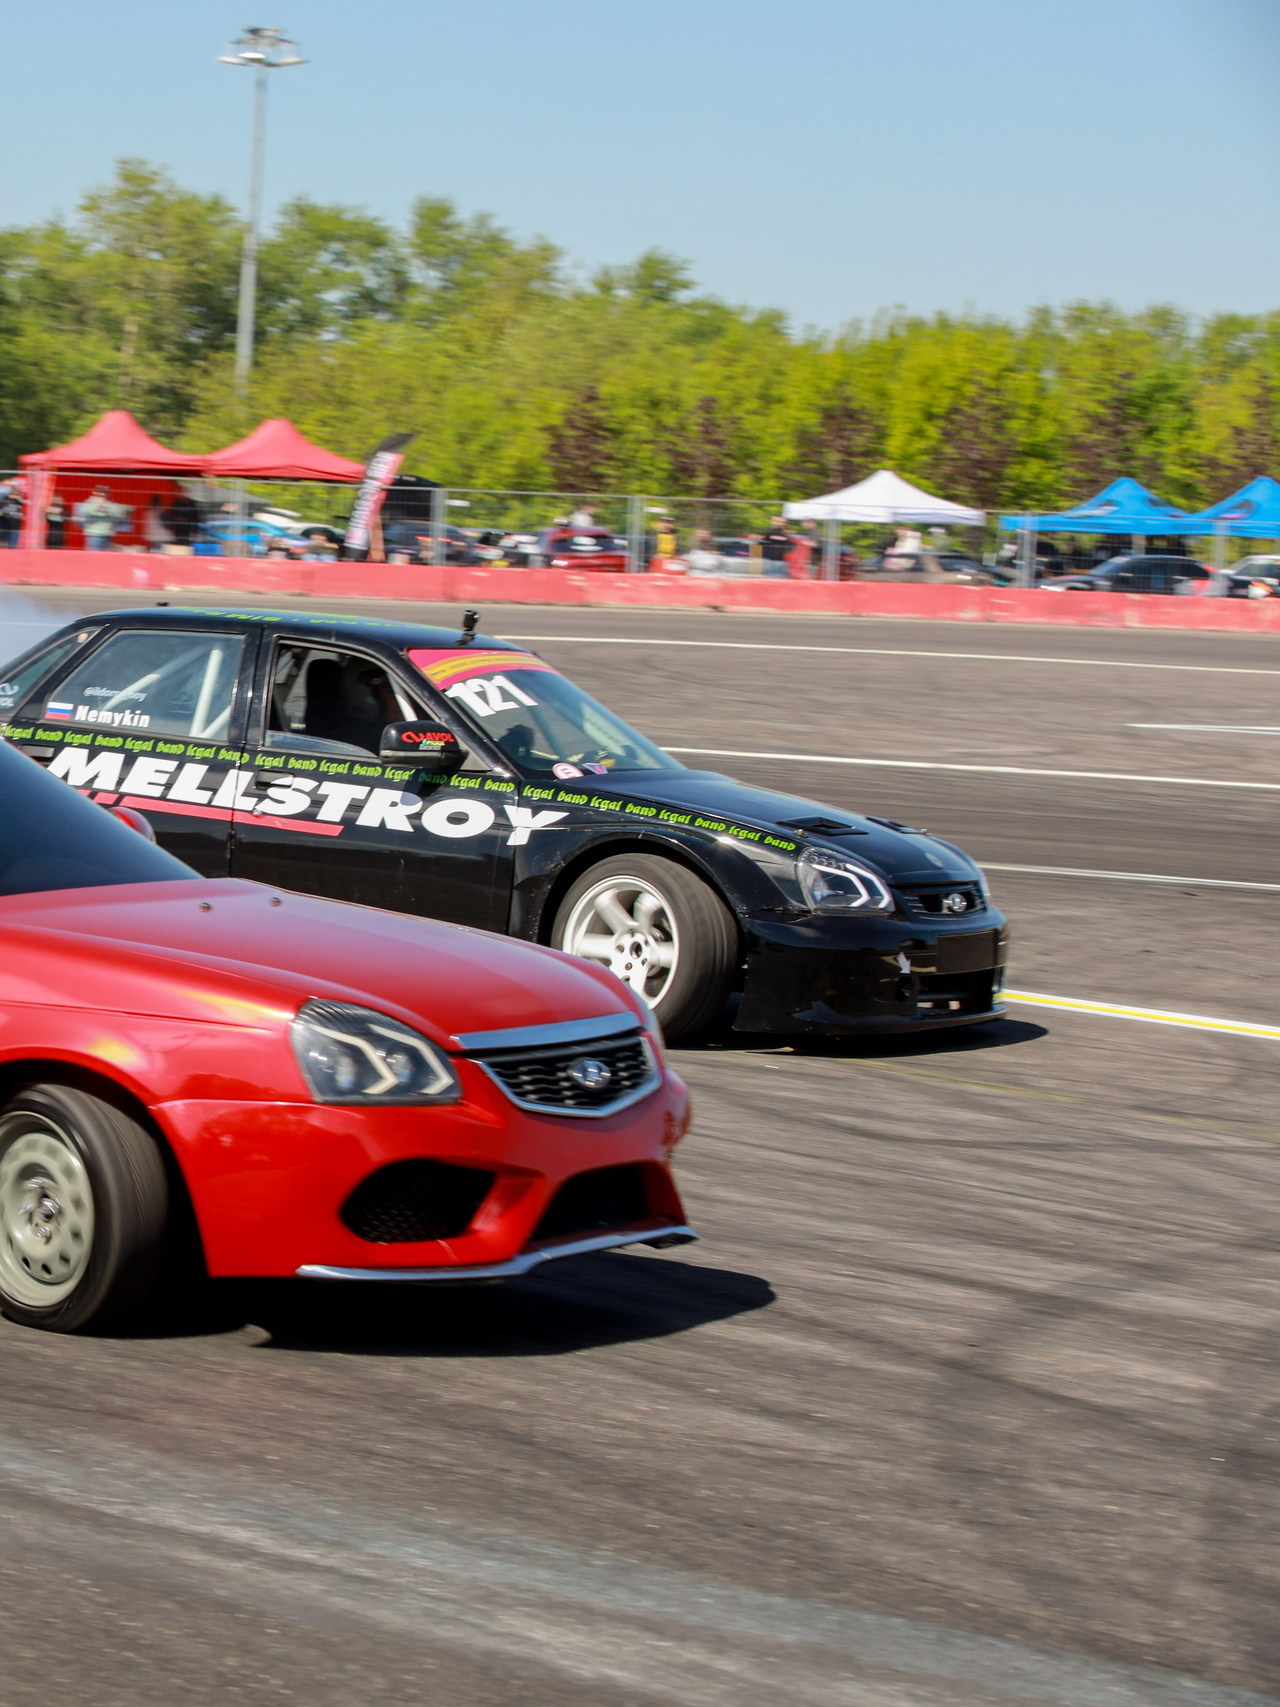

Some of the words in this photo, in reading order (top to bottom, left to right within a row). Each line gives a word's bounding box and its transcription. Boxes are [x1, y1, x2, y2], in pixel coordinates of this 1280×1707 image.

[444, 675, 539, 717] 121
[74, 705, 151, 728] Nemykin
[425, 732, 455, 742] AVOL
[47, 747, 571, 846] MELLSTROY
